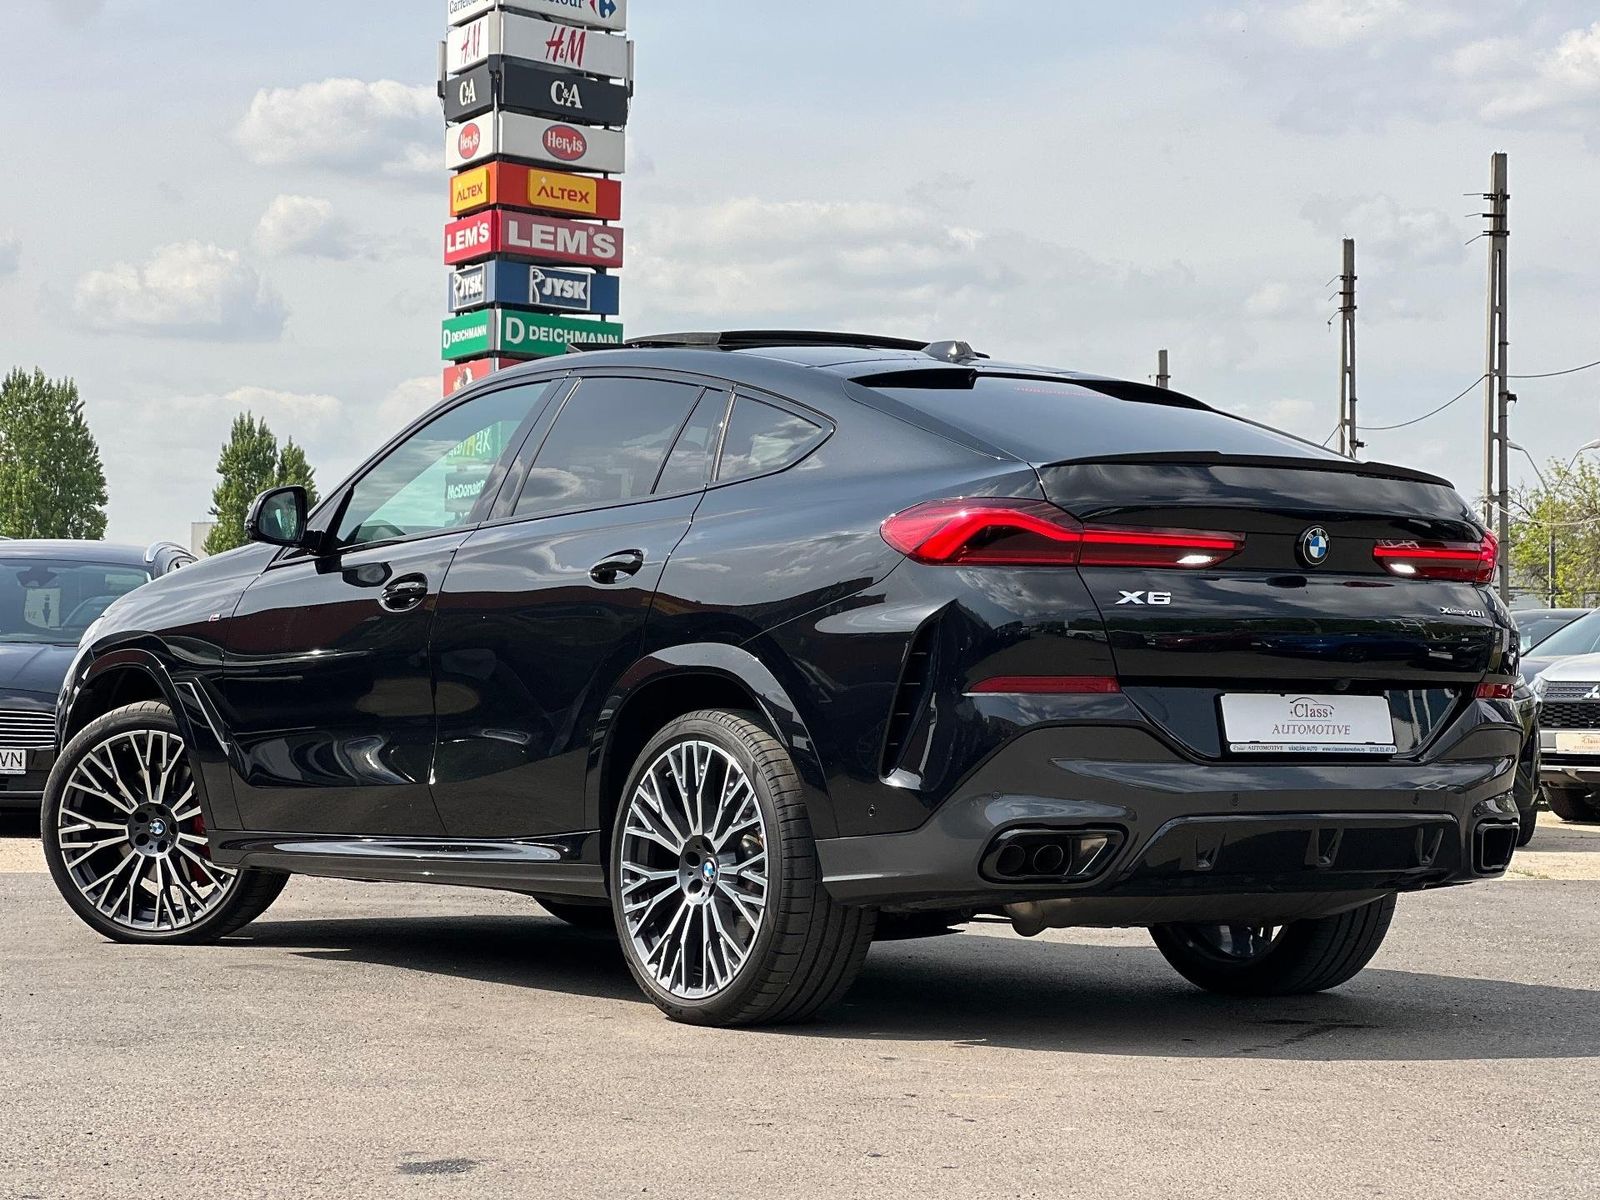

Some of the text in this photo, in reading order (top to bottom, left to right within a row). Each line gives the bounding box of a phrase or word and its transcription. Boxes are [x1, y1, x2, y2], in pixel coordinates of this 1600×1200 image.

[546, 25, 586, 68] H&M
[459, 78, 476, 106] C&A
[550, 80, 583, 109] C&A
[460, 133, 479, 151] Hervis
[548, 132, 583, 154] Hervis
[447, 221, 489, 253] LEM'S
[508, 220, 616, 258] LEM'S
[461, 273, 482, 299] JYSK
[542, 277, 586, 300] JYSK
[451, 324, 487, 342] DEICHMANN
[1115, 590, 1171, 605] X6
[1294, 703, 1329, 718] Class
[1271, 724, 1350, 735] AUTOMOTIVE
